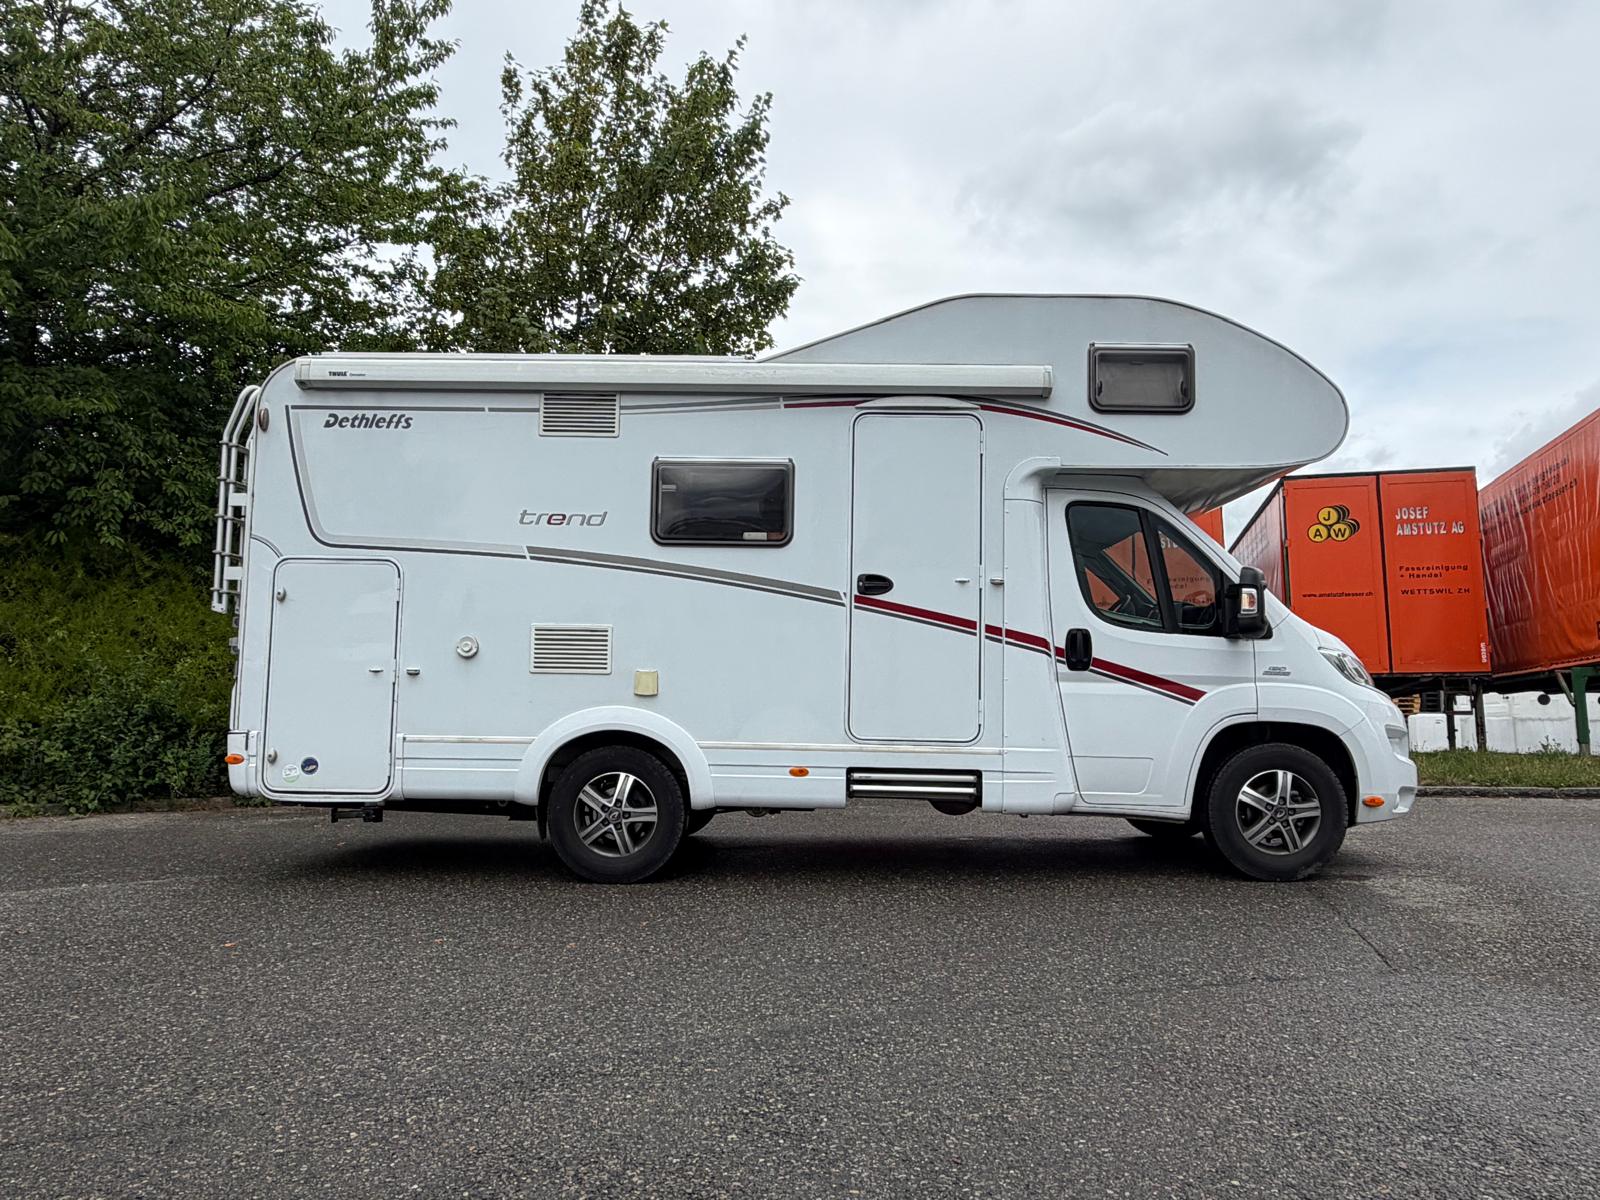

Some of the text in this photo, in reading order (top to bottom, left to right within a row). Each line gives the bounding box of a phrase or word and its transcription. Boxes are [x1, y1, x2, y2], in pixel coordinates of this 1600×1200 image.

[323, 413, 414, 430] Dethleffs
[518, 509, 608, 527] trend
[1395, 507, 1429, 520] JOSEF
[1396, 521, 1465, 536] AMSTUTZ AG
